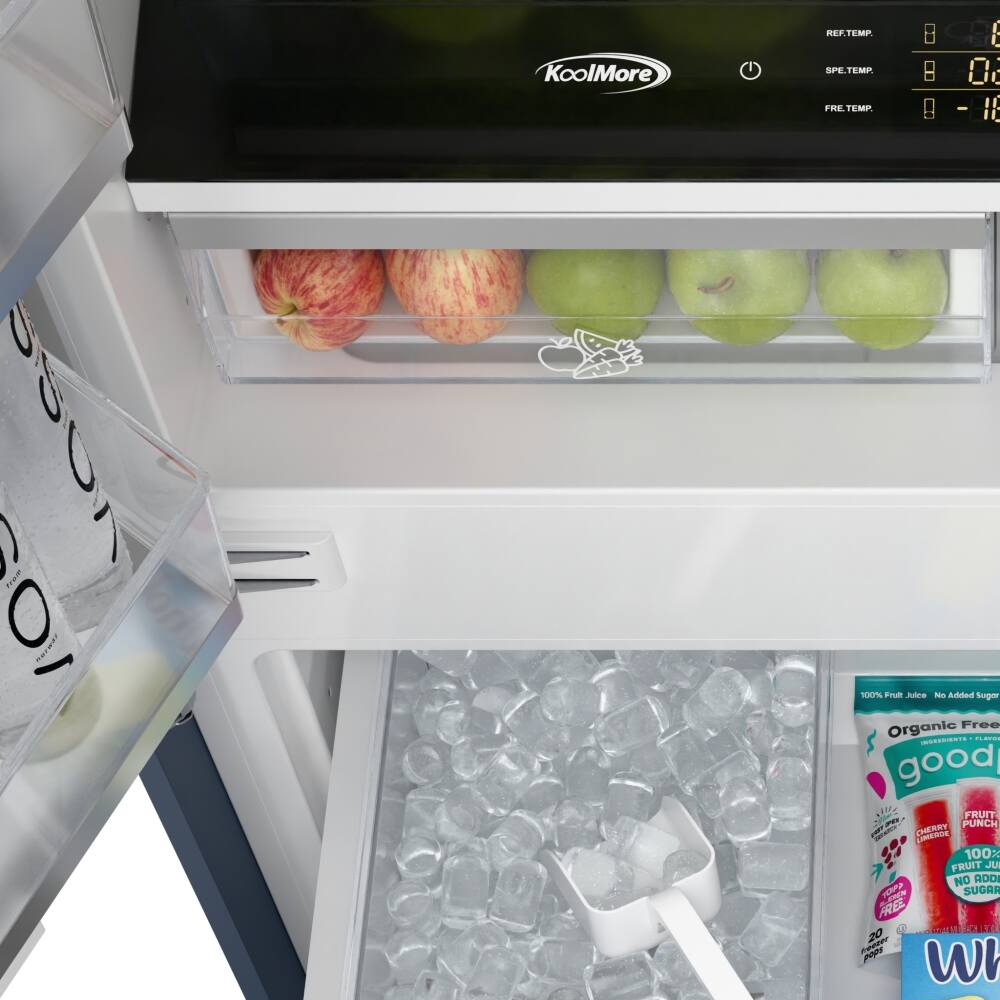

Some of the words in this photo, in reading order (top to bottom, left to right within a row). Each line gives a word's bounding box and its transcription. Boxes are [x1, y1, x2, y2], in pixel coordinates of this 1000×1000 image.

[826, 29, 873, 38] REF.TEMP.
[544, 61, 653, 84] KoolMore
[825, 66, 874, 75] SPE.TEMP.
[860, 691, 884, 699] 100%
[884, 691, 903, 699] Fruit
[905, 691, 927, 699] Juice
[934, 691, 947, 700] No
[948, 691, 975, 700] Added
[975, 691, 1000, 701] Sugar
[888, 720, 958, 739] Organic
[963, 810, 997, 820] FRUIT
[962, 818, 999, 829] PUNCH
[915, 823, 949, 838] CHERRY
[916, 830, 950, 844] LIMEADE
[964, 847, 1000, 860] 100%
[951, 860, 981, 873] FRUIT
[954, 874, 971, 886] NO
[878, 899, 907, 919] FREE
[867, 927, 883, 943] 20
[860, 935, 889, 955] freezer
[863, 946, 884, 963] pops
